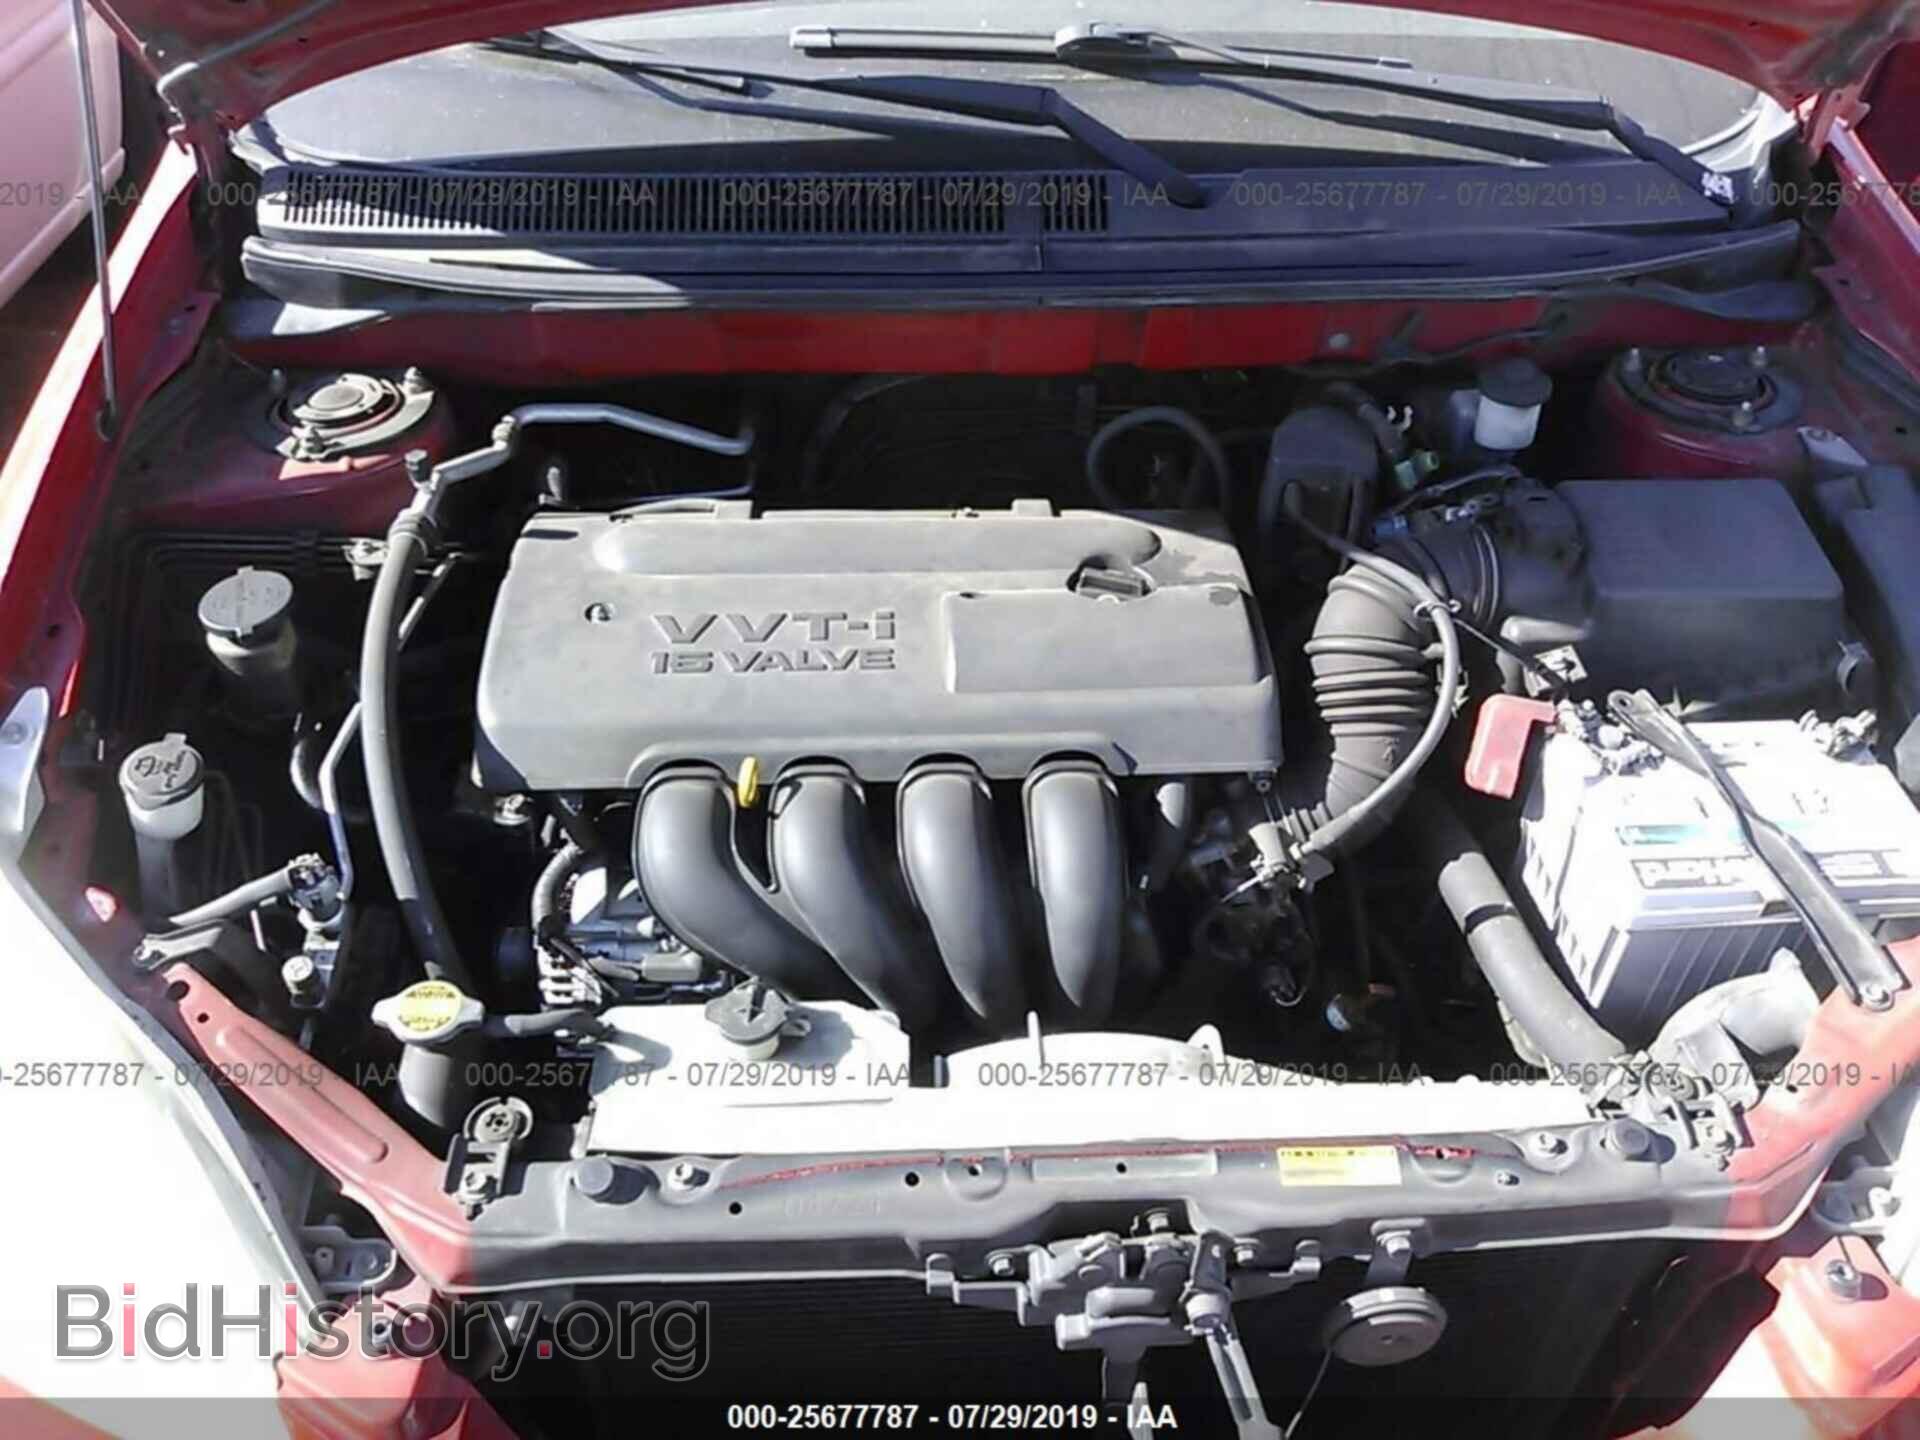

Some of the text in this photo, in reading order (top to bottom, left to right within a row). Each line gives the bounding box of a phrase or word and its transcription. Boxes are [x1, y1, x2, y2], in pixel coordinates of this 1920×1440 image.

[651, 609, 896, 645] VVT-i
[650, 647, 896, 674] 16 VALVE
